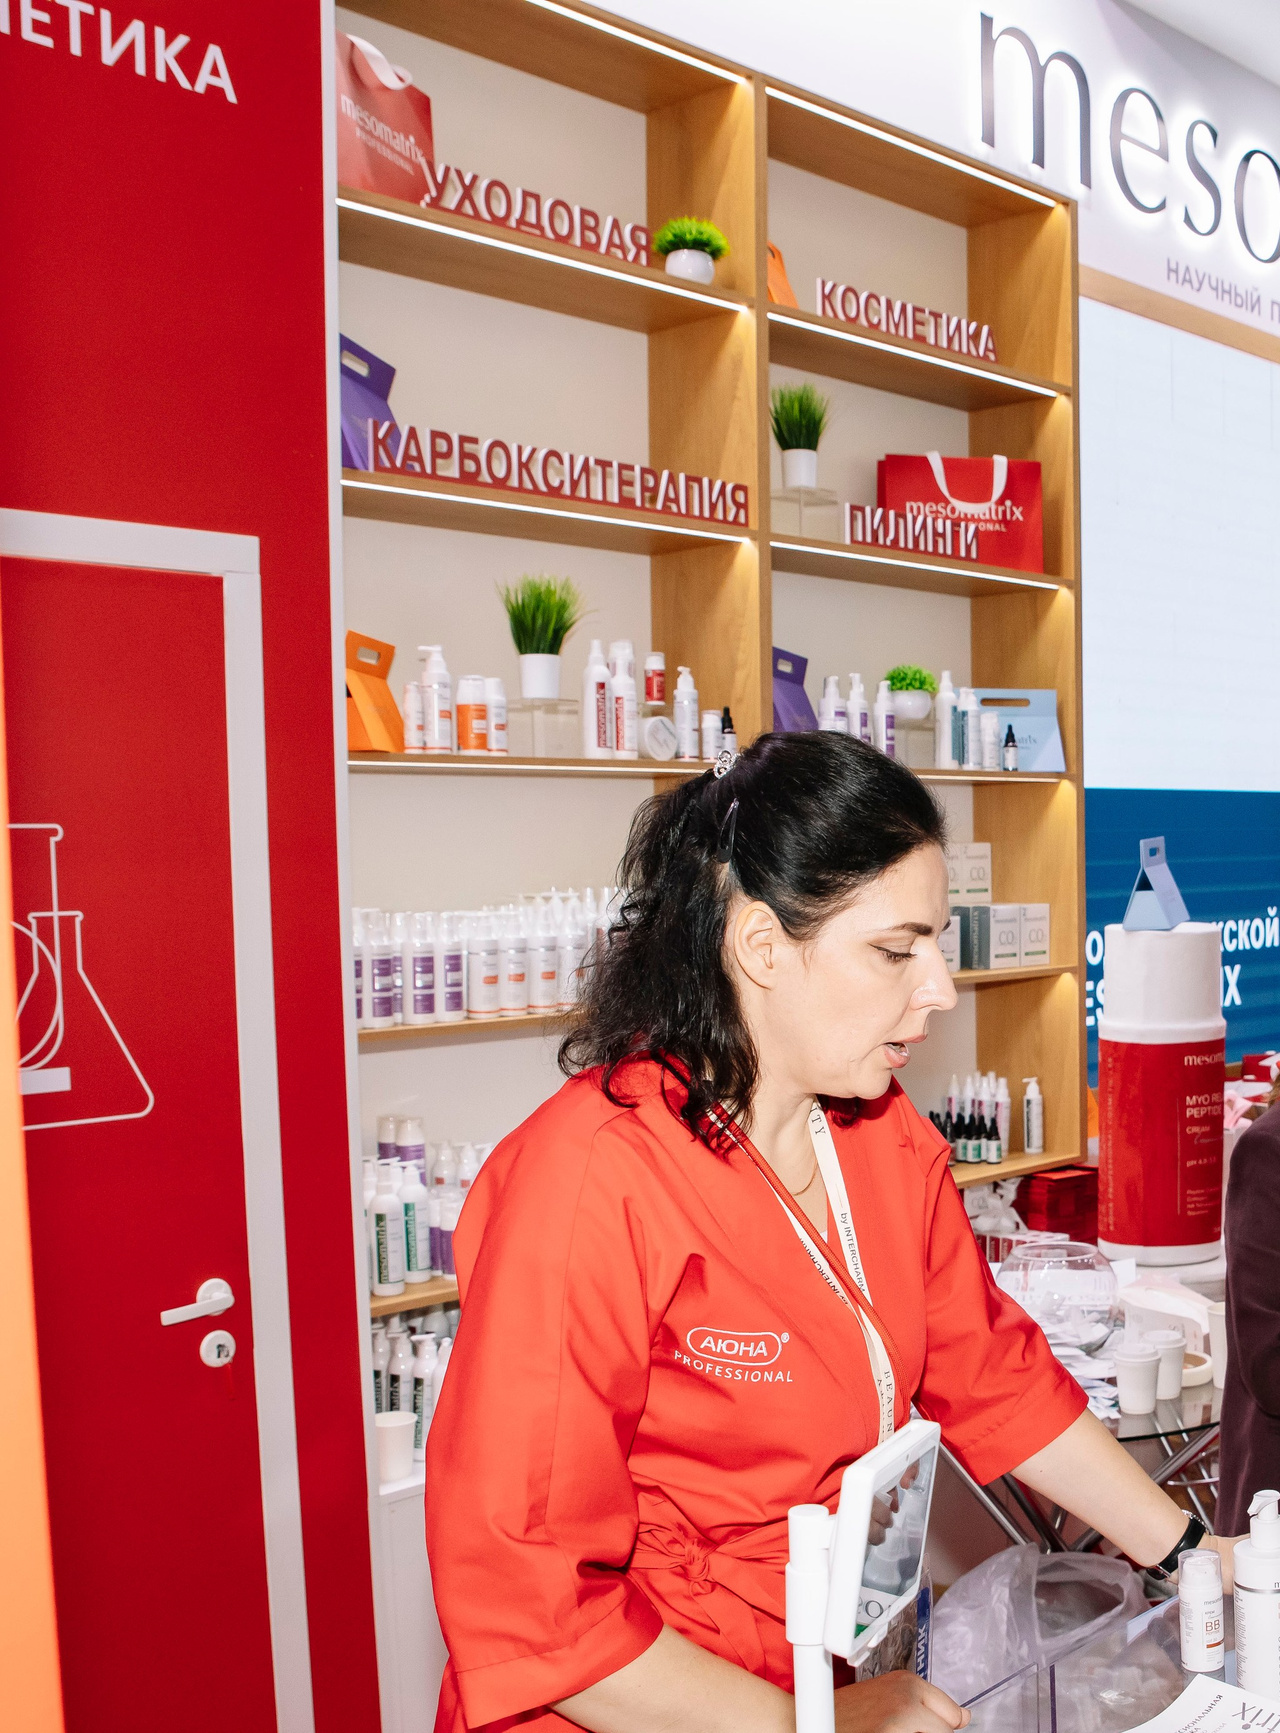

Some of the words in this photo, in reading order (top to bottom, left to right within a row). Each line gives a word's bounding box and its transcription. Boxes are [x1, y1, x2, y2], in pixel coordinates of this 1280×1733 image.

[0, 0, 238, 105] ЕТИКА
[419, 156, 651, 267] УХОДОВАЯ
[1166, 257, 1262, 317] НАУЧНЫЙ
[815, 276, 1000, 364] КОСМЕТИКА
[366, 417, 750, 528] КАРБОКСИТЕРАПИЯ
[1211, 906, 1280, 954] ской
[844, 1226, 866, 1293] INTERCHARM
[673, 1349, 794, 1383] PROFESSIONAL
[883, 1370, 894, 1433] BEAUN
[1205, 1619, 1221, 1633] BB
